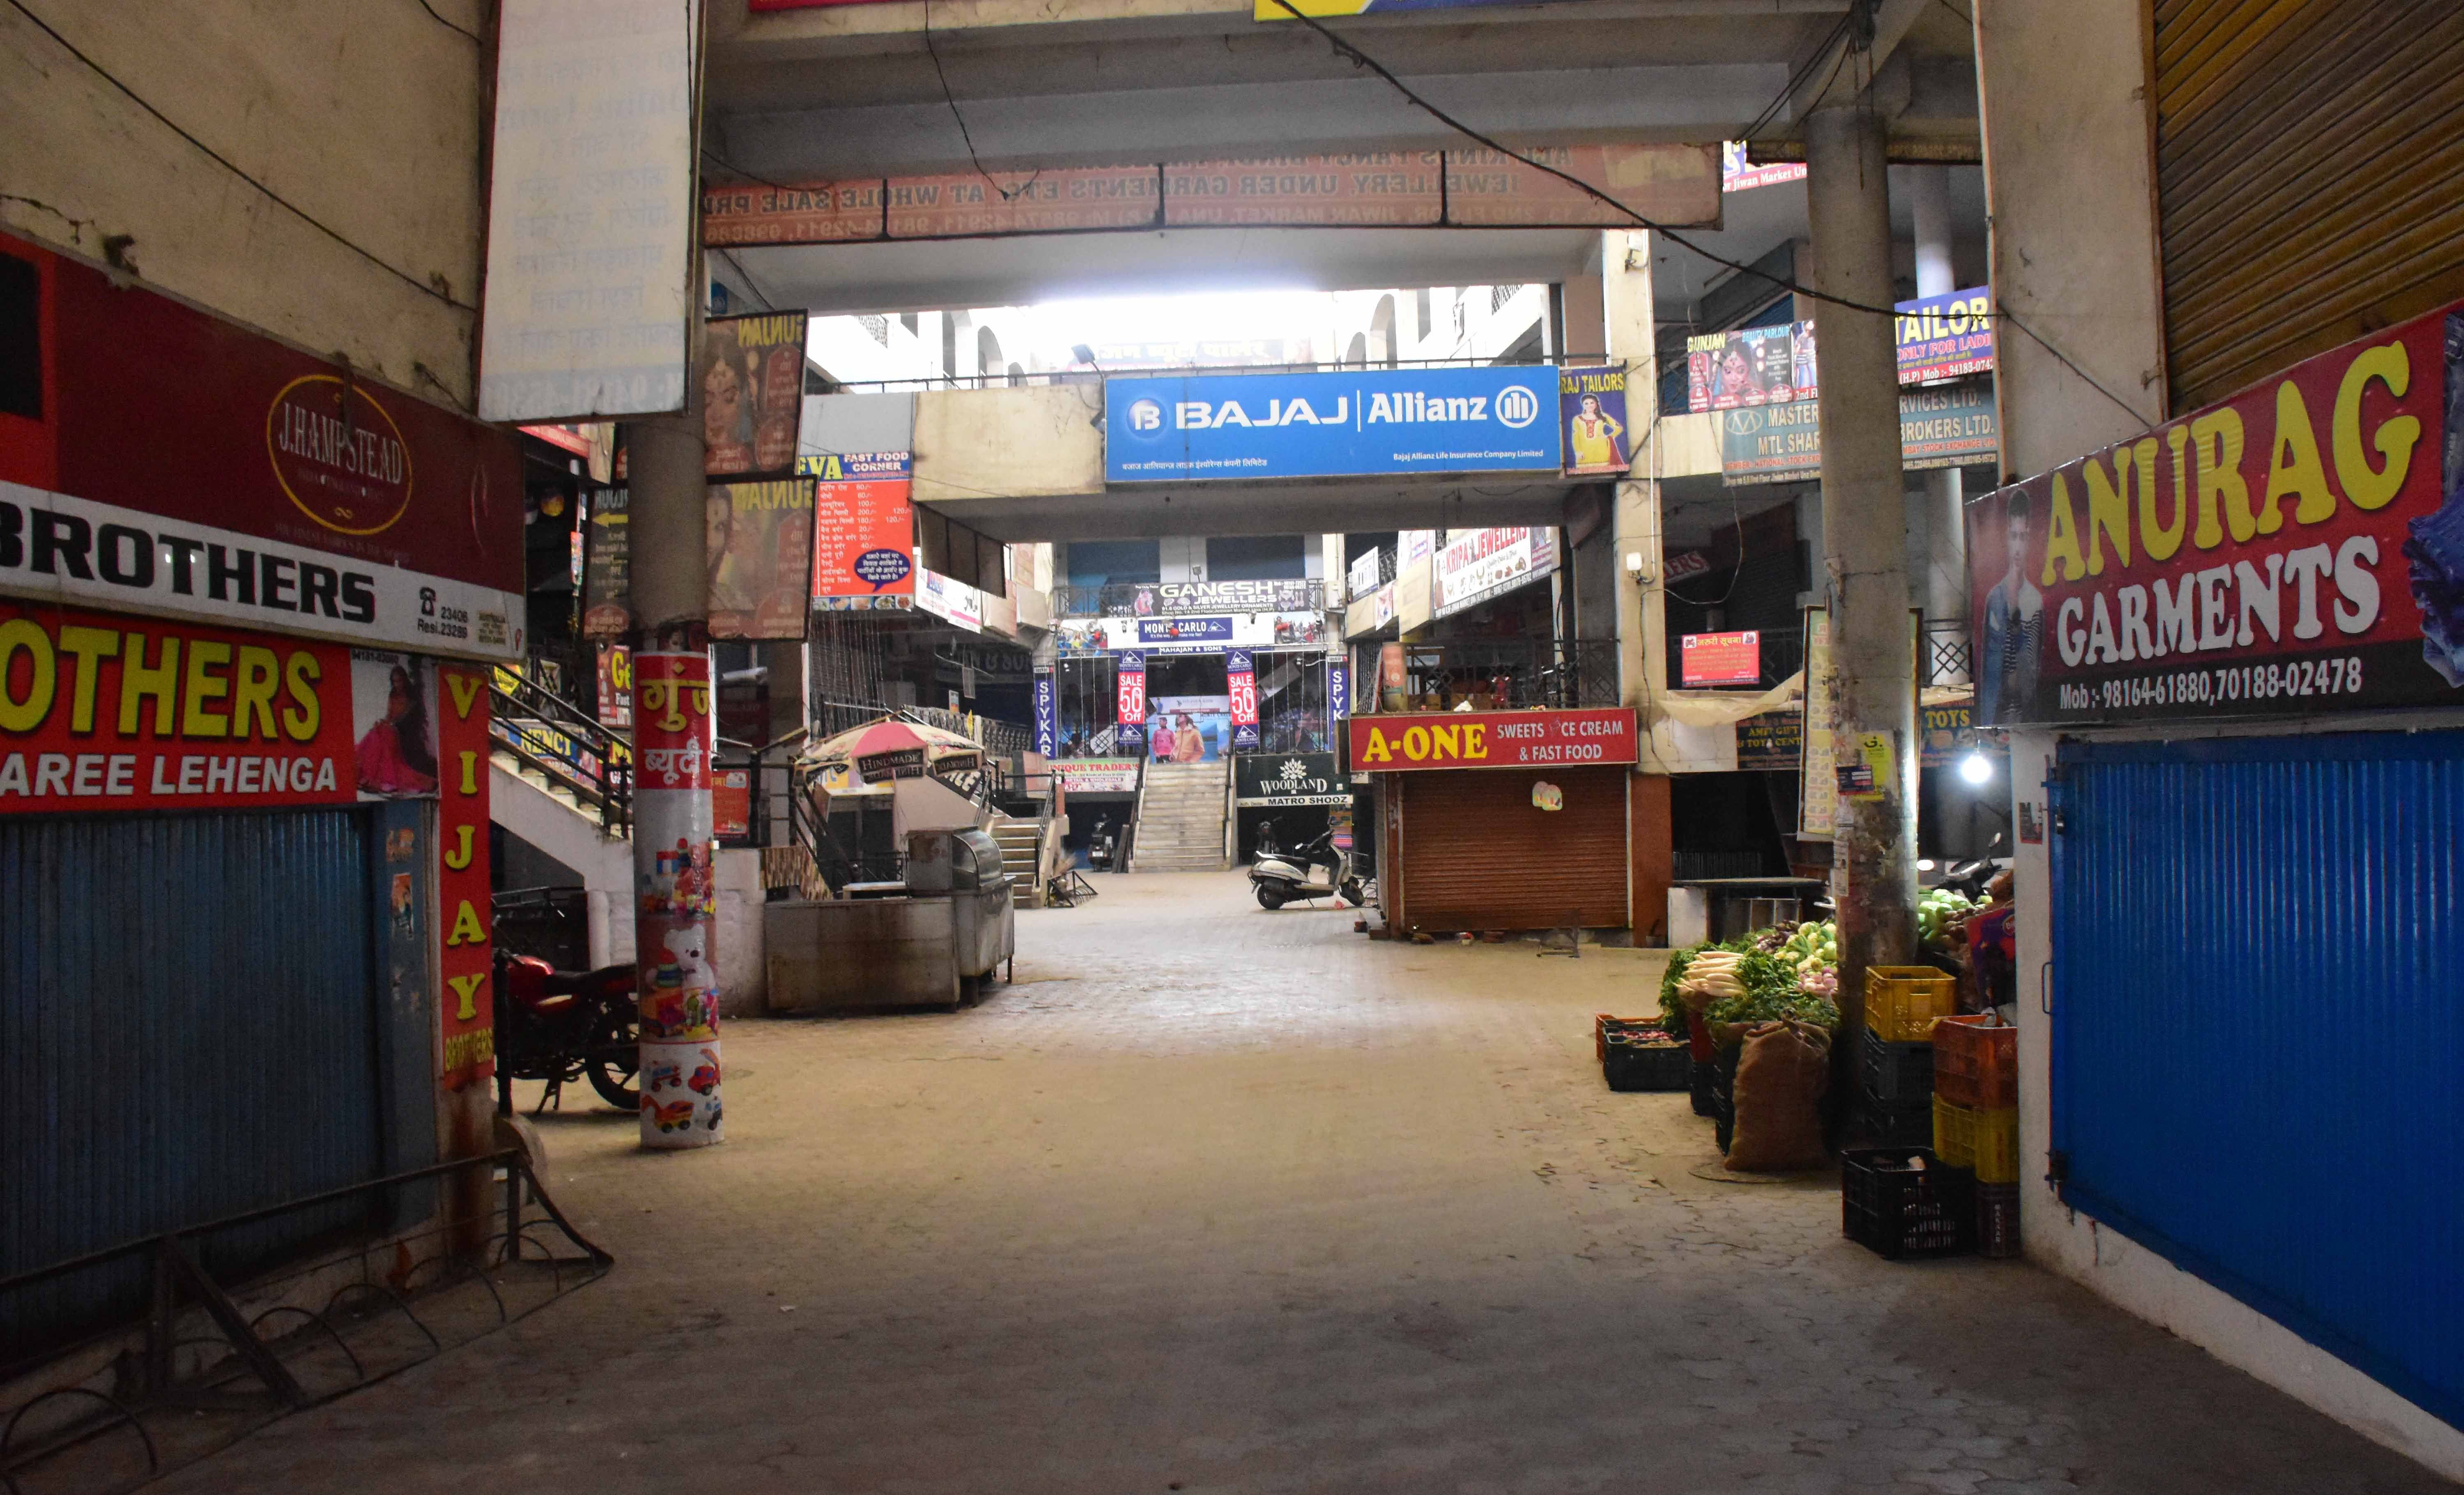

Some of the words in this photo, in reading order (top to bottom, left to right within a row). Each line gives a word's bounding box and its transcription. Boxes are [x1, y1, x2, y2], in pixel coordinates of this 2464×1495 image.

[1733, 177, 1758, 191] Jiwan
[1761, 170, 1791, 183] Market
[1687, 333, 1726, 353] GUNJAN
[1930, 339, 1956, 356] FOR
[1561, 375, 1580, 394] RAJ
[1582, 373, 1625, 393] TAILORS
[1923, 368, 1939, 380] Mob
[1176, 397, 1348, 430] BAJAJ
[1368, 391, 1487, 423] Allianz
[1768, 403, 1819, 427] MASTER
[1965, 414, 1995, 436] LTD.
[1393, 453, 1411, 462] Bajaj
[1484, 450, 1516, 460] Company
[1758, 435, 1784, 456] MTL
[844, 453, 873, 463] FAST
[877, 451, 909, 461] FOOD
[852, 462, 901, 472] CORNER
[2041, 339, 2420, 587] ANURAG
[1446, 545, 1469, 575] KRIPA
[1160, 581, 1273, 598] GANESH
[1194, 595, 1277, 605] JEWELLERS
[2057, 534, 2380, 667] GARMENTS
[1178, 621, 1206, 632] CARLO
[0, 619, 322, 741] OTHERS
[1120, 675, 1142, 686] SALE
[1230, 675, 1252, 687] SALE
[1119, 686, 1143, 713] 50
[1231, 686, 1255, 714] 50
[1333, 671, 1343, 722] SPYK
[2059, 682, 2090, 710] Mob
[1039, 682, 1052, 757] SPYKAR
[1124, 713, 1141, 722] Off
[1237, 713, 1255, 722] Off
[1925, 709, 1970, 729] TOYS
[1497, 723, 1544, 739] SWEETS
[1579, 720, 1623, 736] CREAM
[1362, 723, 1488, 763] A-ONE
[1519, 745, 1529, 761] &
[1532, 745, 1562, 761] FAST
[1565, 743, 1602, 759] FOOD
[0, 752, 135, 797] AREE
[150, 754, 337, 795] LEHENGA
[1260, 778, 1327, 796] WOODLAND
[444, 674, 486, 1021] VIJAY
